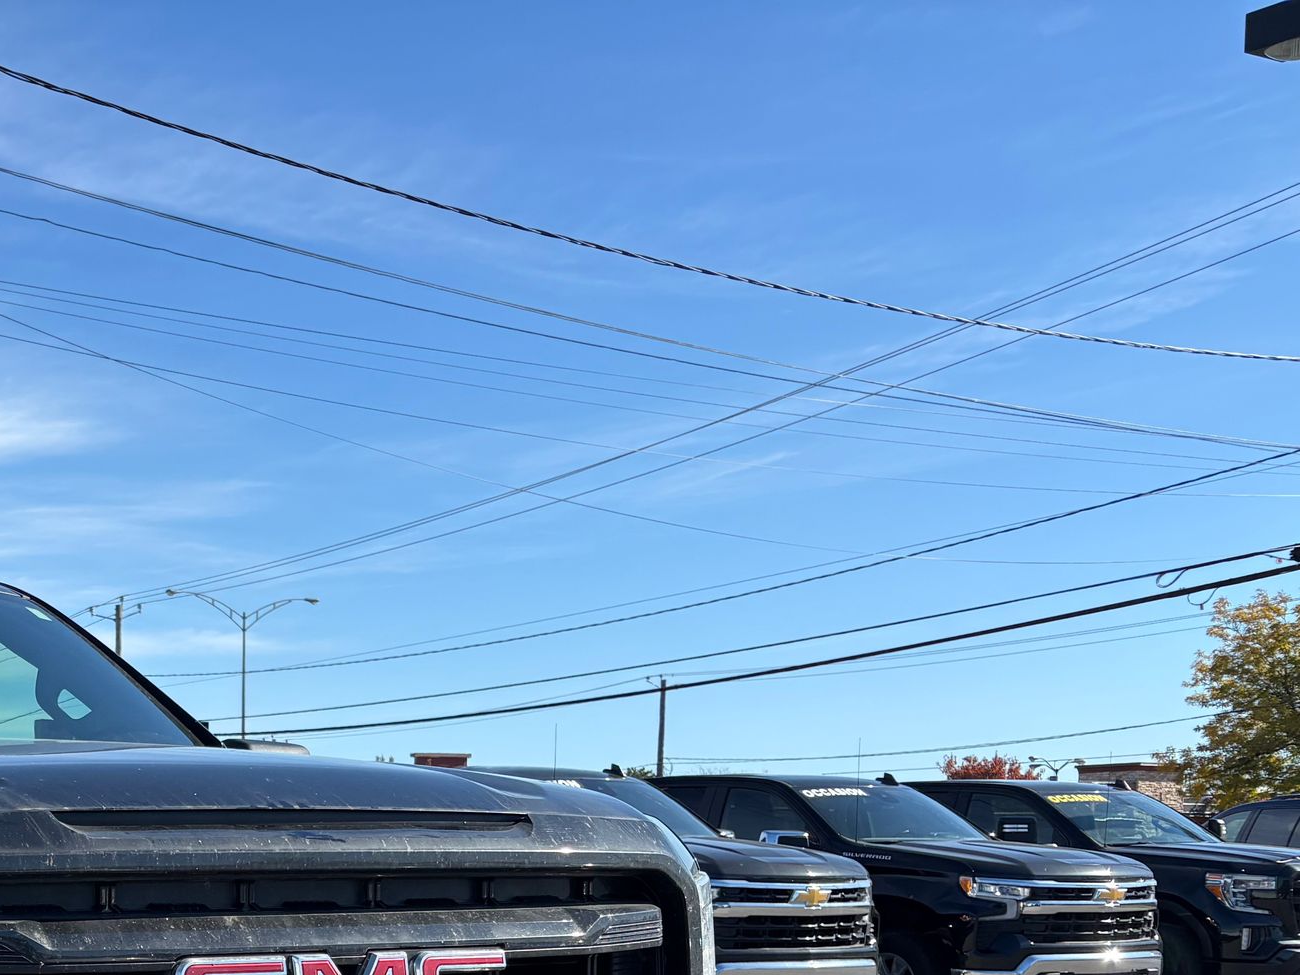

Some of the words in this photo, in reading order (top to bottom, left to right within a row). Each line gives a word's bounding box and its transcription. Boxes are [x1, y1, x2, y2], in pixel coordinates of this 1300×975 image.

[802, 787, 868, 798] OCCASION
[1046, 794, 1109, 804] OCCASION
[842, 851, 892, 861] SILVERADO
